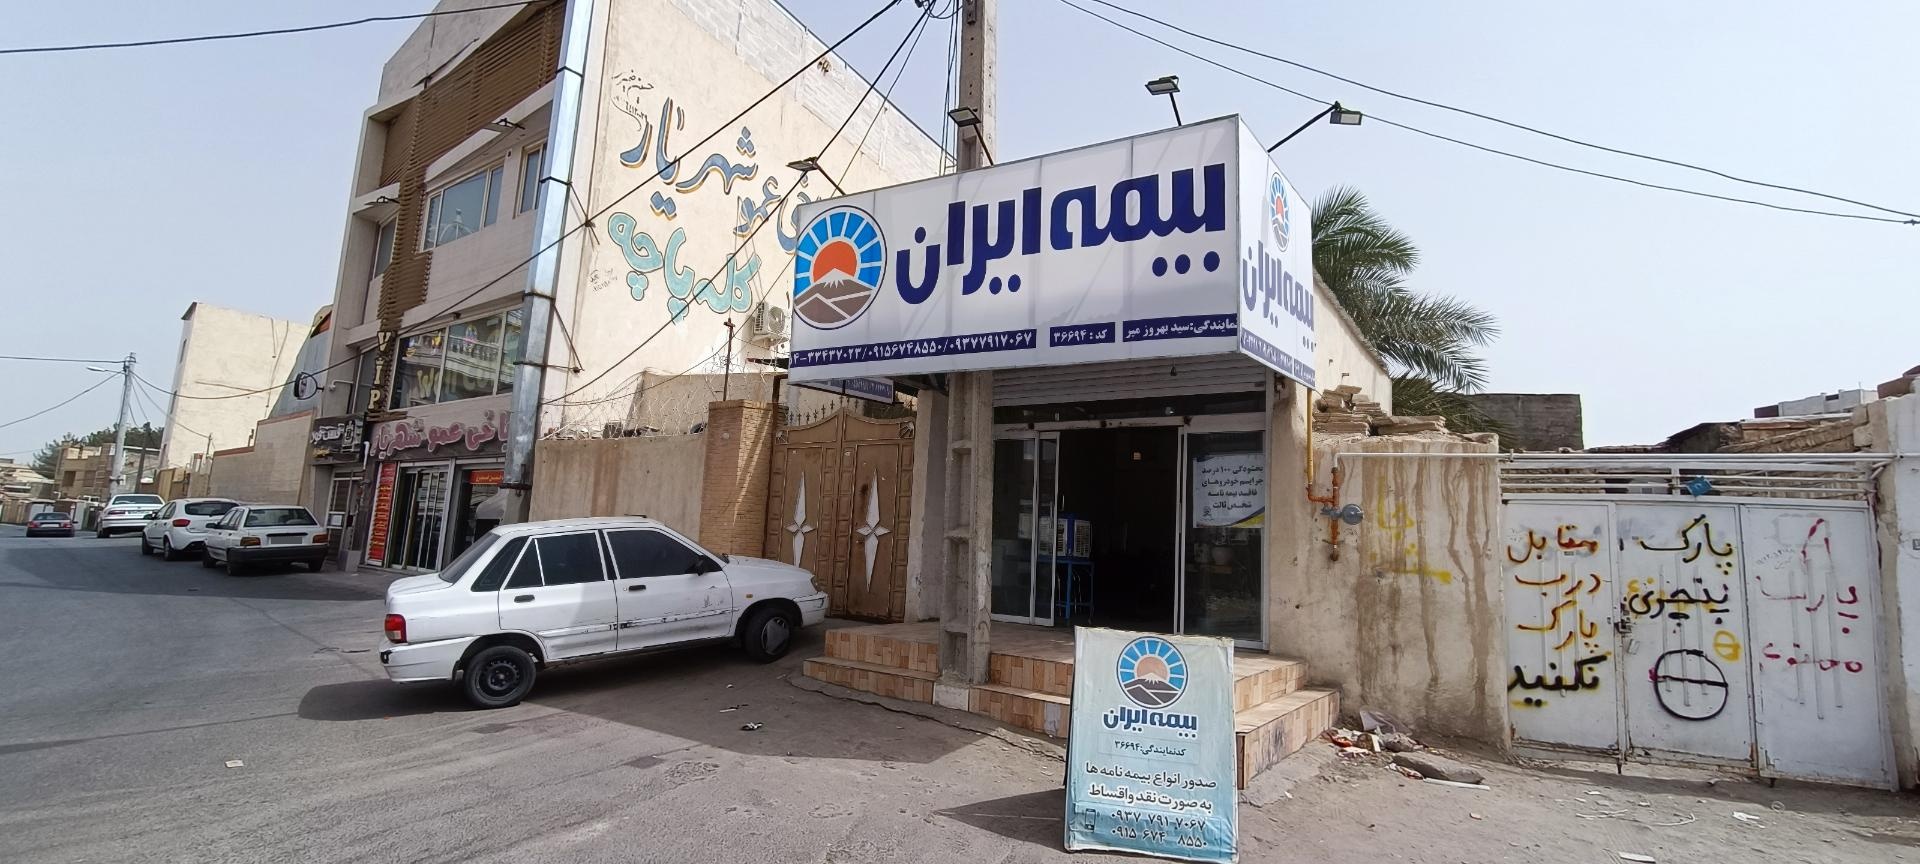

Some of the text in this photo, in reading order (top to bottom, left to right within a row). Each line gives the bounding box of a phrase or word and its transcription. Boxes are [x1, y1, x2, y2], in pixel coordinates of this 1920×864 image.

[619, 97, 758, 222] شهریار
[1050, 163, 1226, 278] بیمه
[896, 186, 1042, 305] ایران
[1242, 239, 1282, 329] ایران
[1053, 329, 1087, 343] ۳۶۶۹۴
[1125, 327, 1141, 339] میر
[1143, 324, 1169, 338] بهروز
[368, 331, 392, 410] VIP
[1507, 524, 1599, 564] مقابل
[1638, 514, 1734, 576] پارک
[1514, 573, 1601, 598] درب
[1516, 599, 1599, 654] پارک
[1103, 706, 1198, 739] بیمه ایران
[1085, 761, 1217, 791] صدور انواع بیمه نامه ها
[1135, 790, 1157, 804] نقد
[1159, 795, 1198, 811] صورت
[1199, 800, 1213, 815] به
[1111, 809, 1206, 832] ۰۹۳۷ ۷۹۱ ۷۰۶۷
[1111, 826, 1208, 848] ۰۹۱۵ ۶۷۴ ۸۵۵۰
